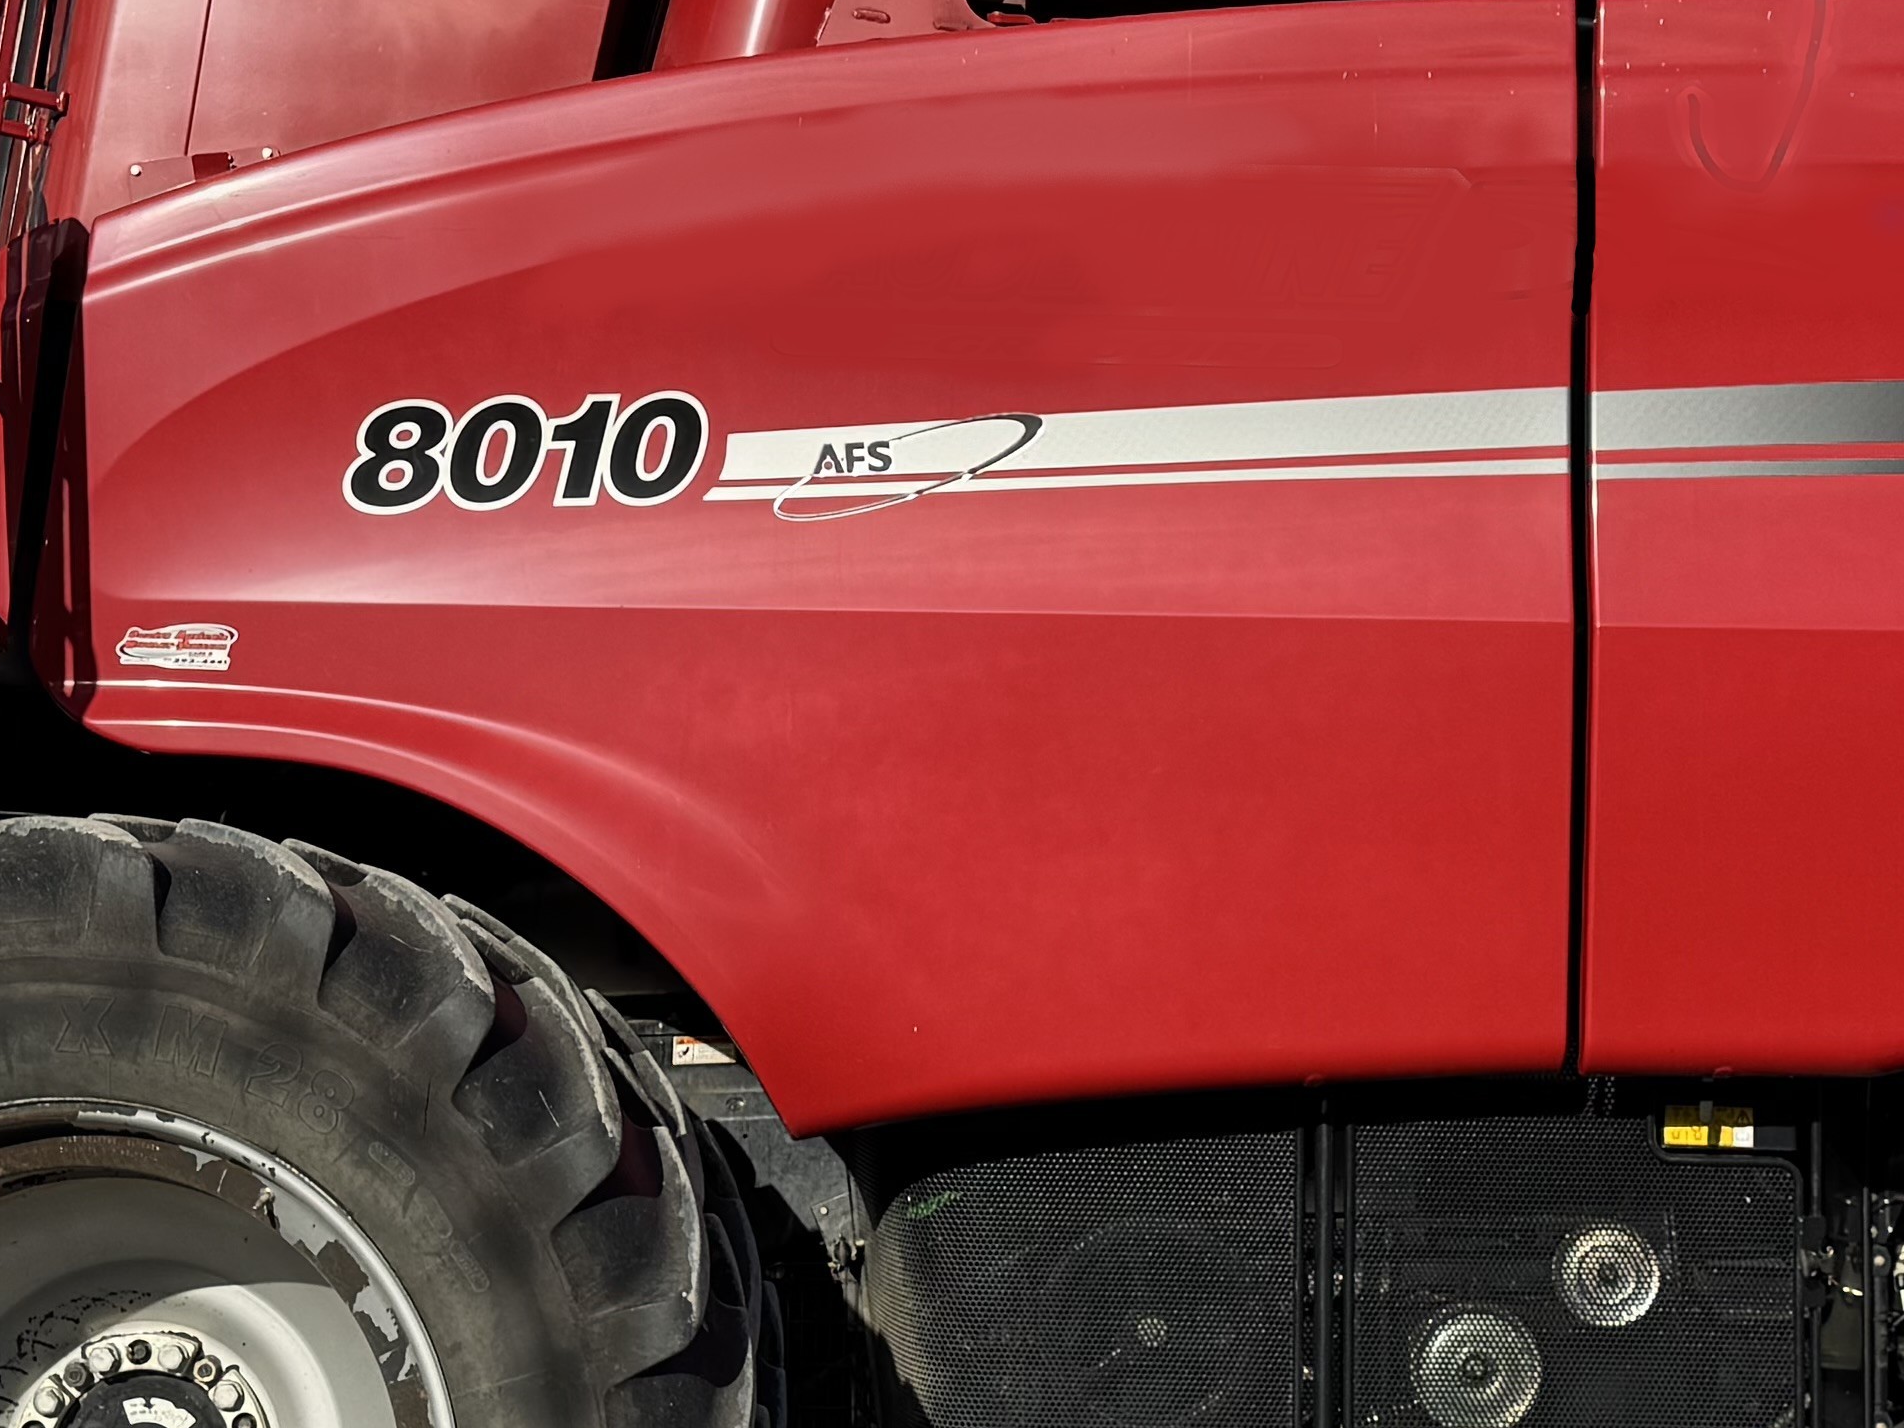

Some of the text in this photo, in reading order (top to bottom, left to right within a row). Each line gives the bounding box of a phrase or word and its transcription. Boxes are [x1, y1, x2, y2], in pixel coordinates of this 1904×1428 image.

[344, 391, 709, 514] 8010
[813, 441, 893, 477] AFS
[243, 1042, 357, 1137] 28
